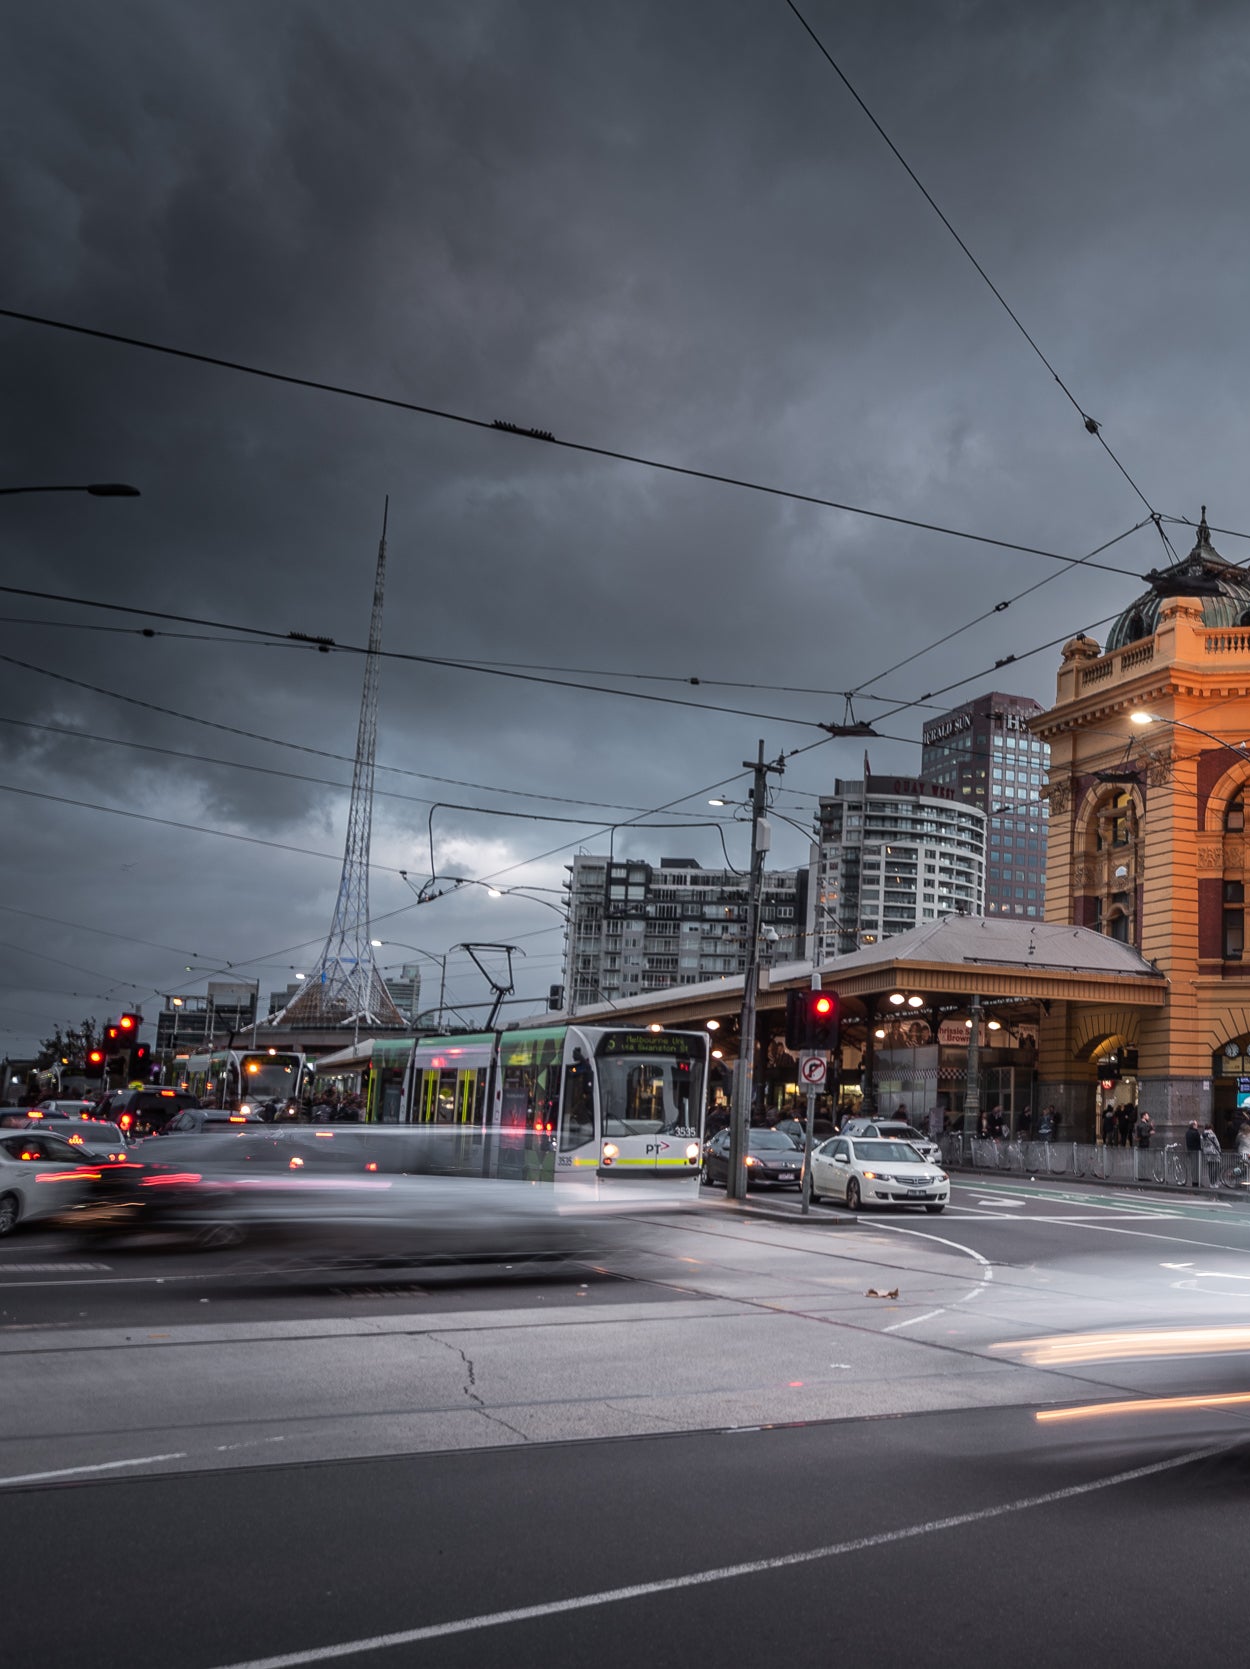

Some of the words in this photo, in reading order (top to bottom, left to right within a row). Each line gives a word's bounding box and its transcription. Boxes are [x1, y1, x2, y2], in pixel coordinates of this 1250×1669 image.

[954, 714, 972, 731] SUN
[894, 780, 925, 794] QUAY
[931, 785, 955, 799] WEST
[939, 1026, 964, 1035] hrissie
[626, 1036, 669, 1045] Melbourne
[675, 1126, 696, 1137] 3535
